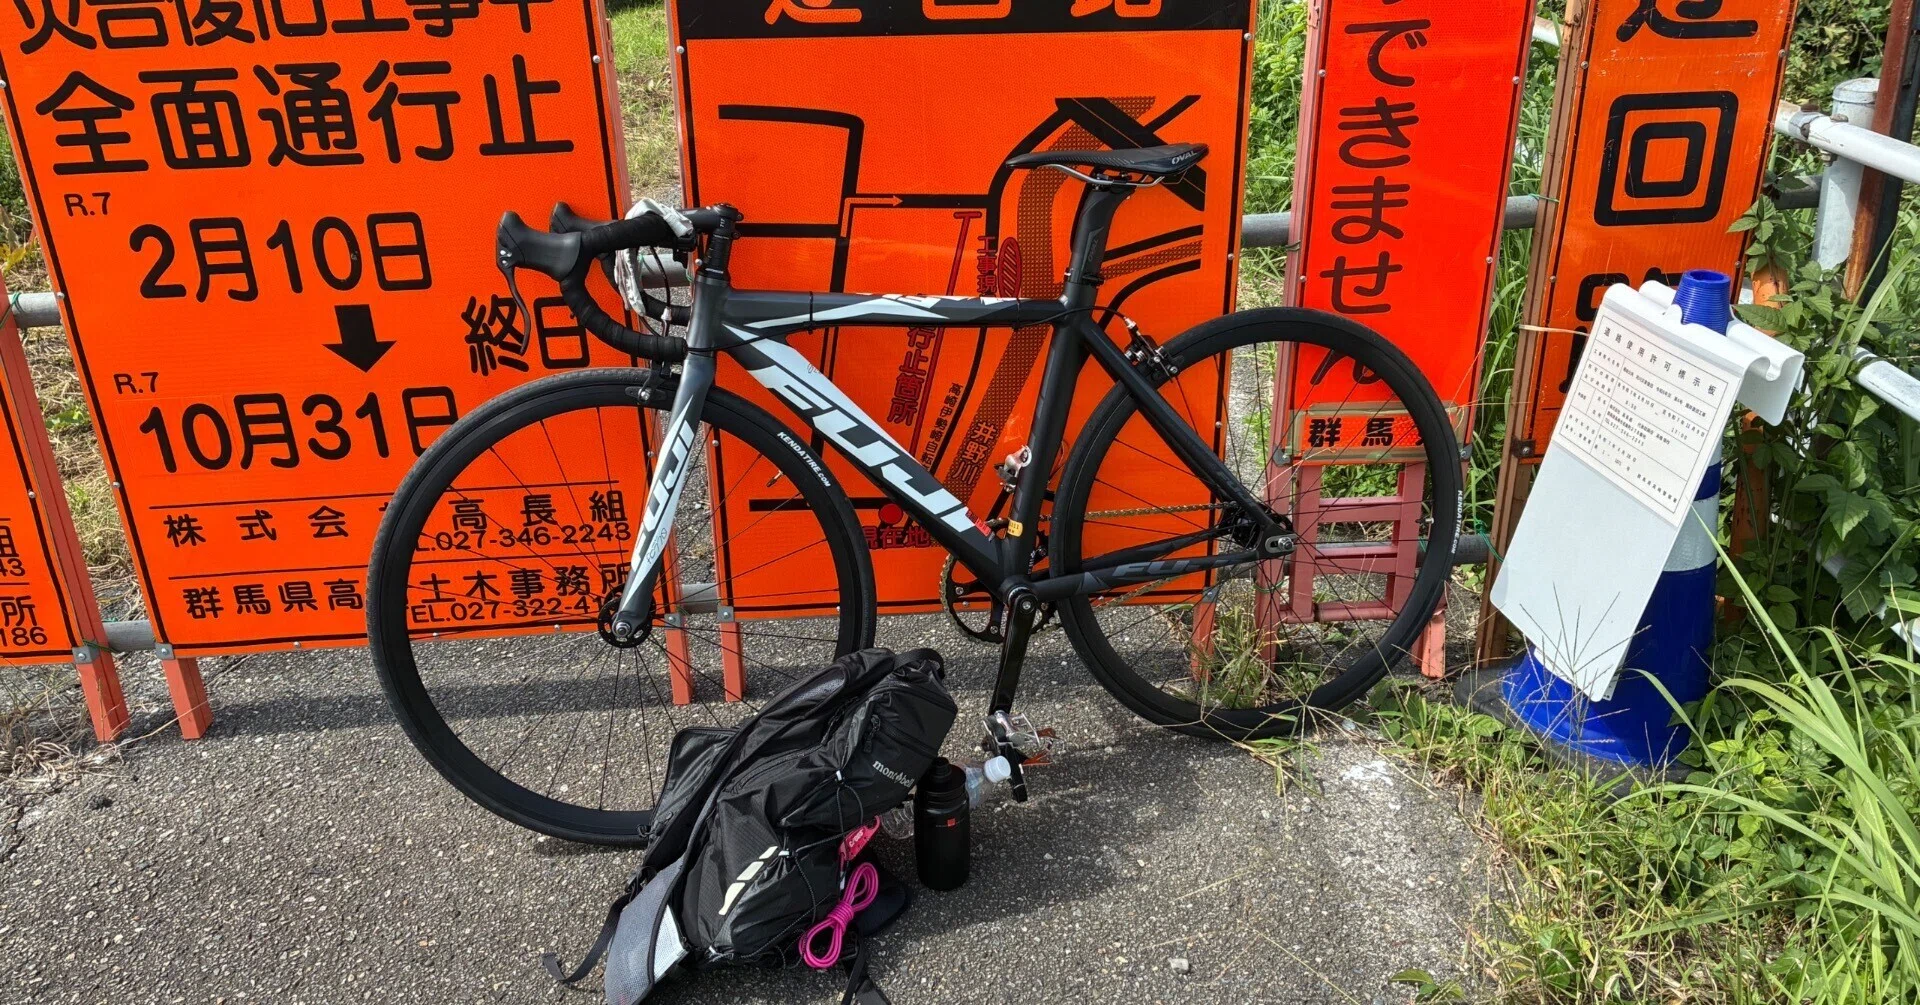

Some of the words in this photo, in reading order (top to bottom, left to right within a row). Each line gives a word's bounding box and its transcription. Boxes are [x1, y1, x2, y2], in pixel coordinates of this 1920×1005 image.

[35, 54, 575, 176] 全面通行止
[1171, 149, 1198, 165] OVAL
[64, 191, 111, 217] R.7
[1309, 0, 1432, 385] できません
[129, 211, 433, 302] 2月10日
[977, 235, 998, 295] 工事現
[460, 293, 591, 376] 終日
[114, 372, 160, 395] R.7
[886, 324, 938, 427] 行止箇所
[139, 385, 459, 474] 10月31日
[747, 364, 977, 533] FUJI
[776, 431, 831, 487] KENDATIRE.COM
[952, 420, 998, 485] 井野川
[1308, 417, 1425, 448] 群馬
[631, 420, 695, 573] FUJI
[414, 522, 632, 553] L.027-346-2243
[862, 525, 932, 550] 現在地
